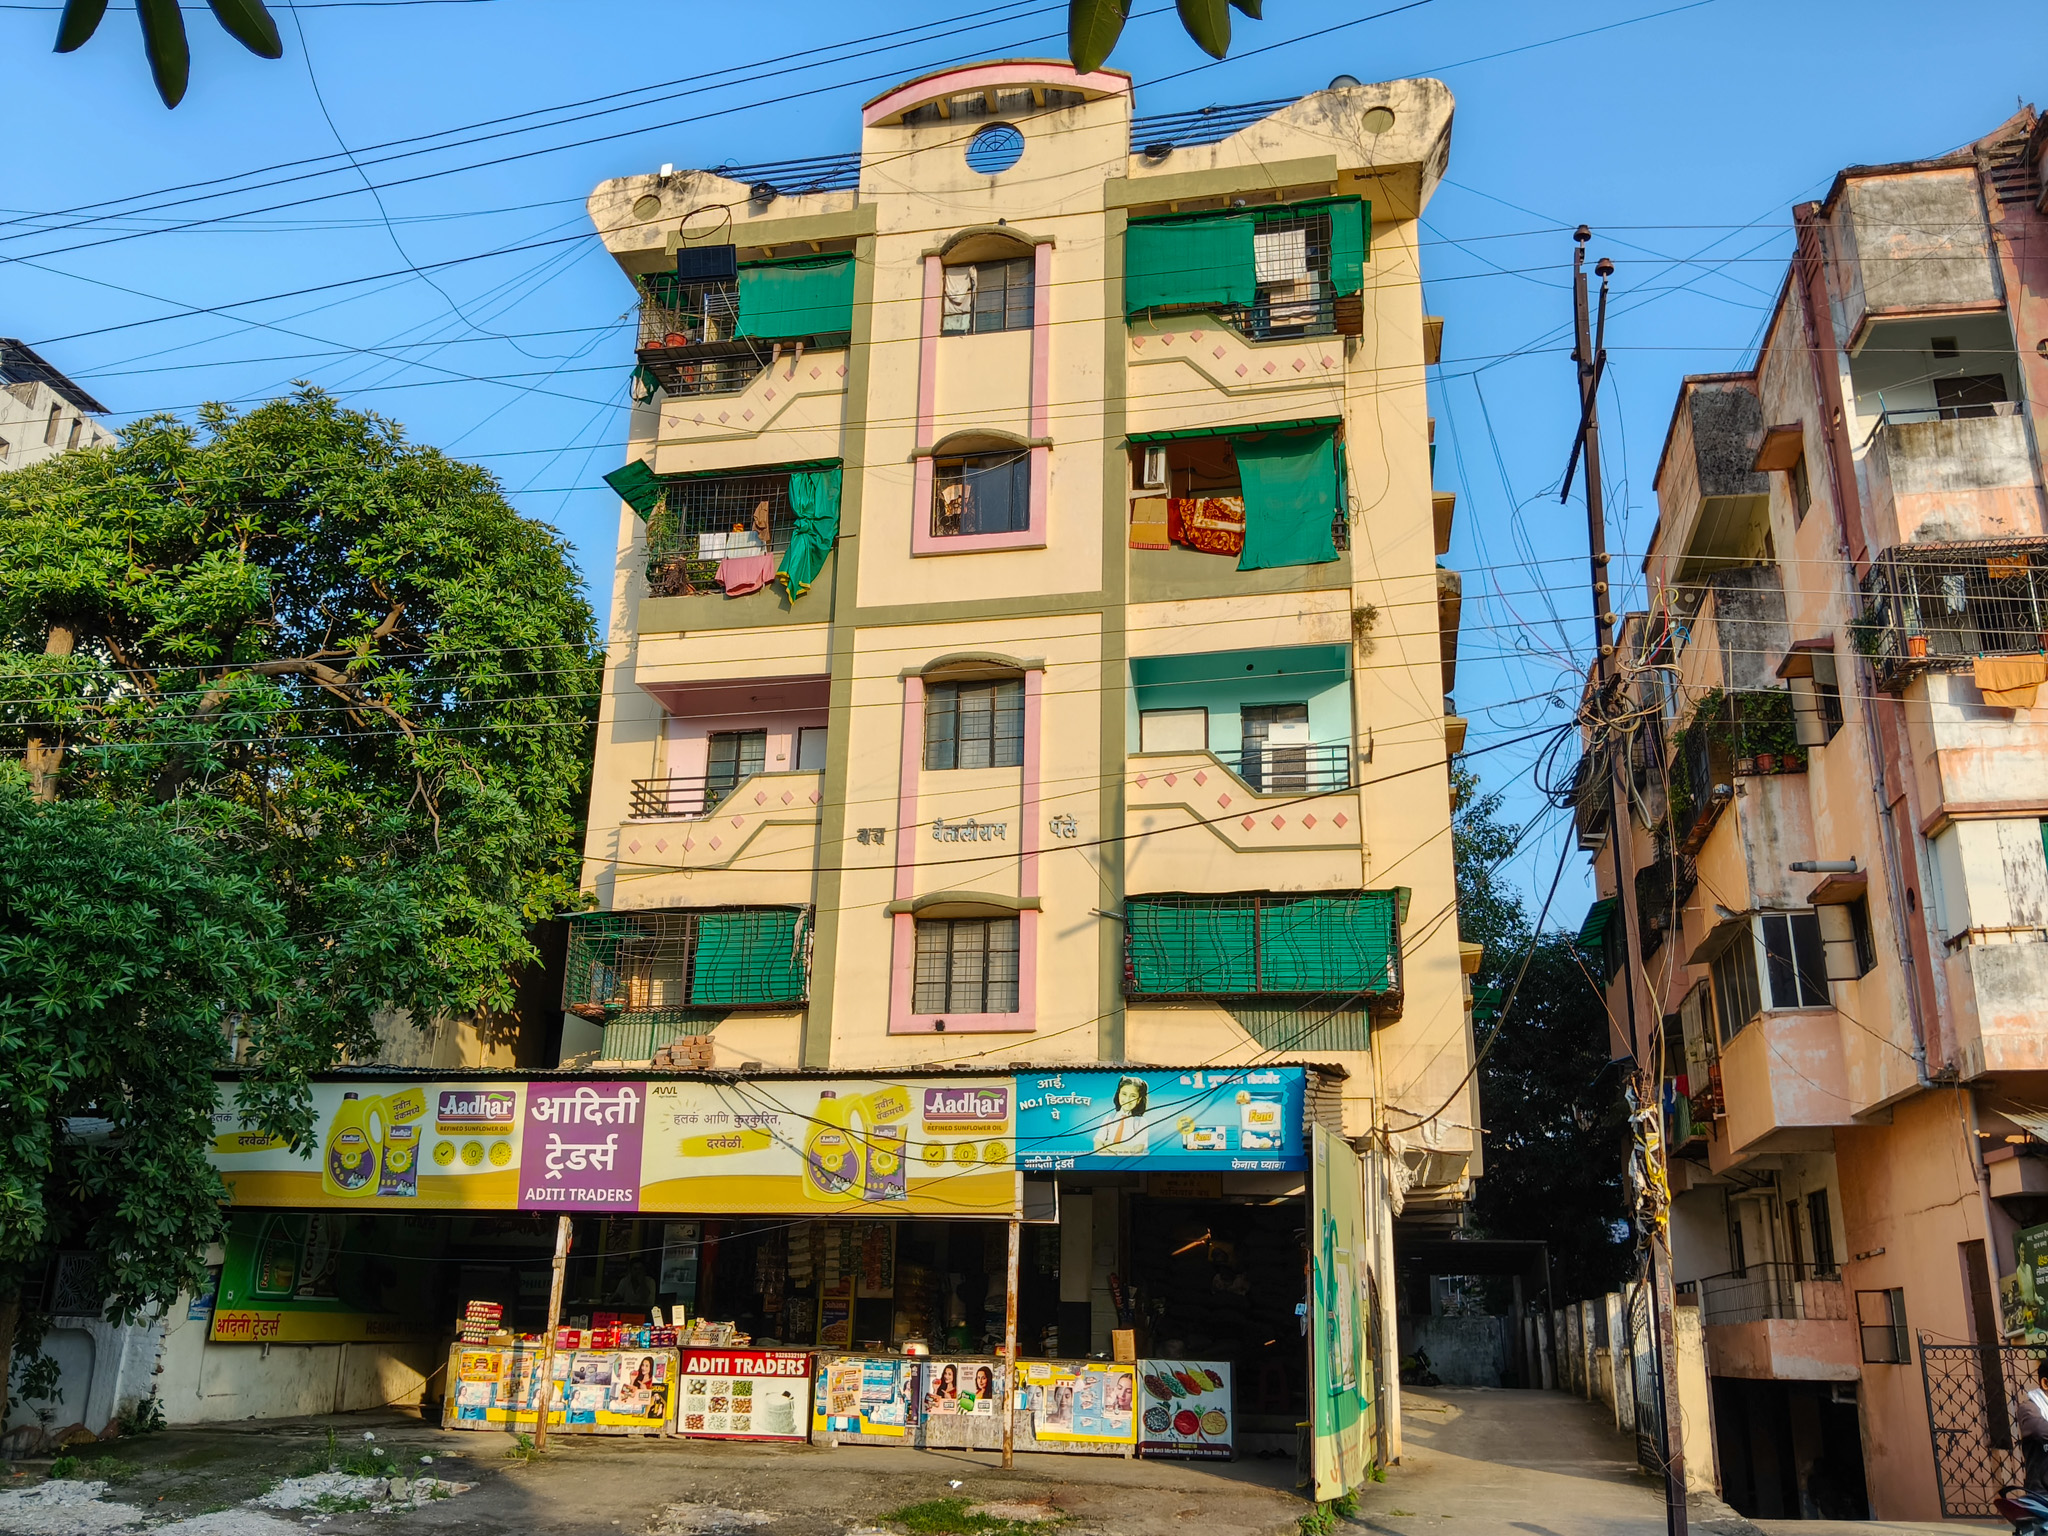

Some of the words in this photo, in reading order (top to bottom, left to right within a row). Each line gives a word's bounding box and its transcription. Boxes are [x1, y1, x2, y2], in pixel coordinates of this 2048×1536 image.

[1037, 1074, 1065, 1089] आई,
[440, 1095, 513, 1120] Aadhar
[531, 1087, 640, 1126] आदिती
[926, 1092, 1005, 1118] Aadhar
[1019, 1097, 1043, 1111] NO.1
[704, 1111, 729, 1124] आणि
[544, 1133, 619, 1180] ट्रेडर्स
[525, 1188, 566, 1201] ADITI
[569, 1189, 632, 1202] TRADERS
[214, 1314, 251, 1337] अदिती
[252, 1313, 282, 1340] ट्रेडर्स
[686, 1357, 730, 1373] ADITI
[734, 1358, 805, 1375] TRADERS
